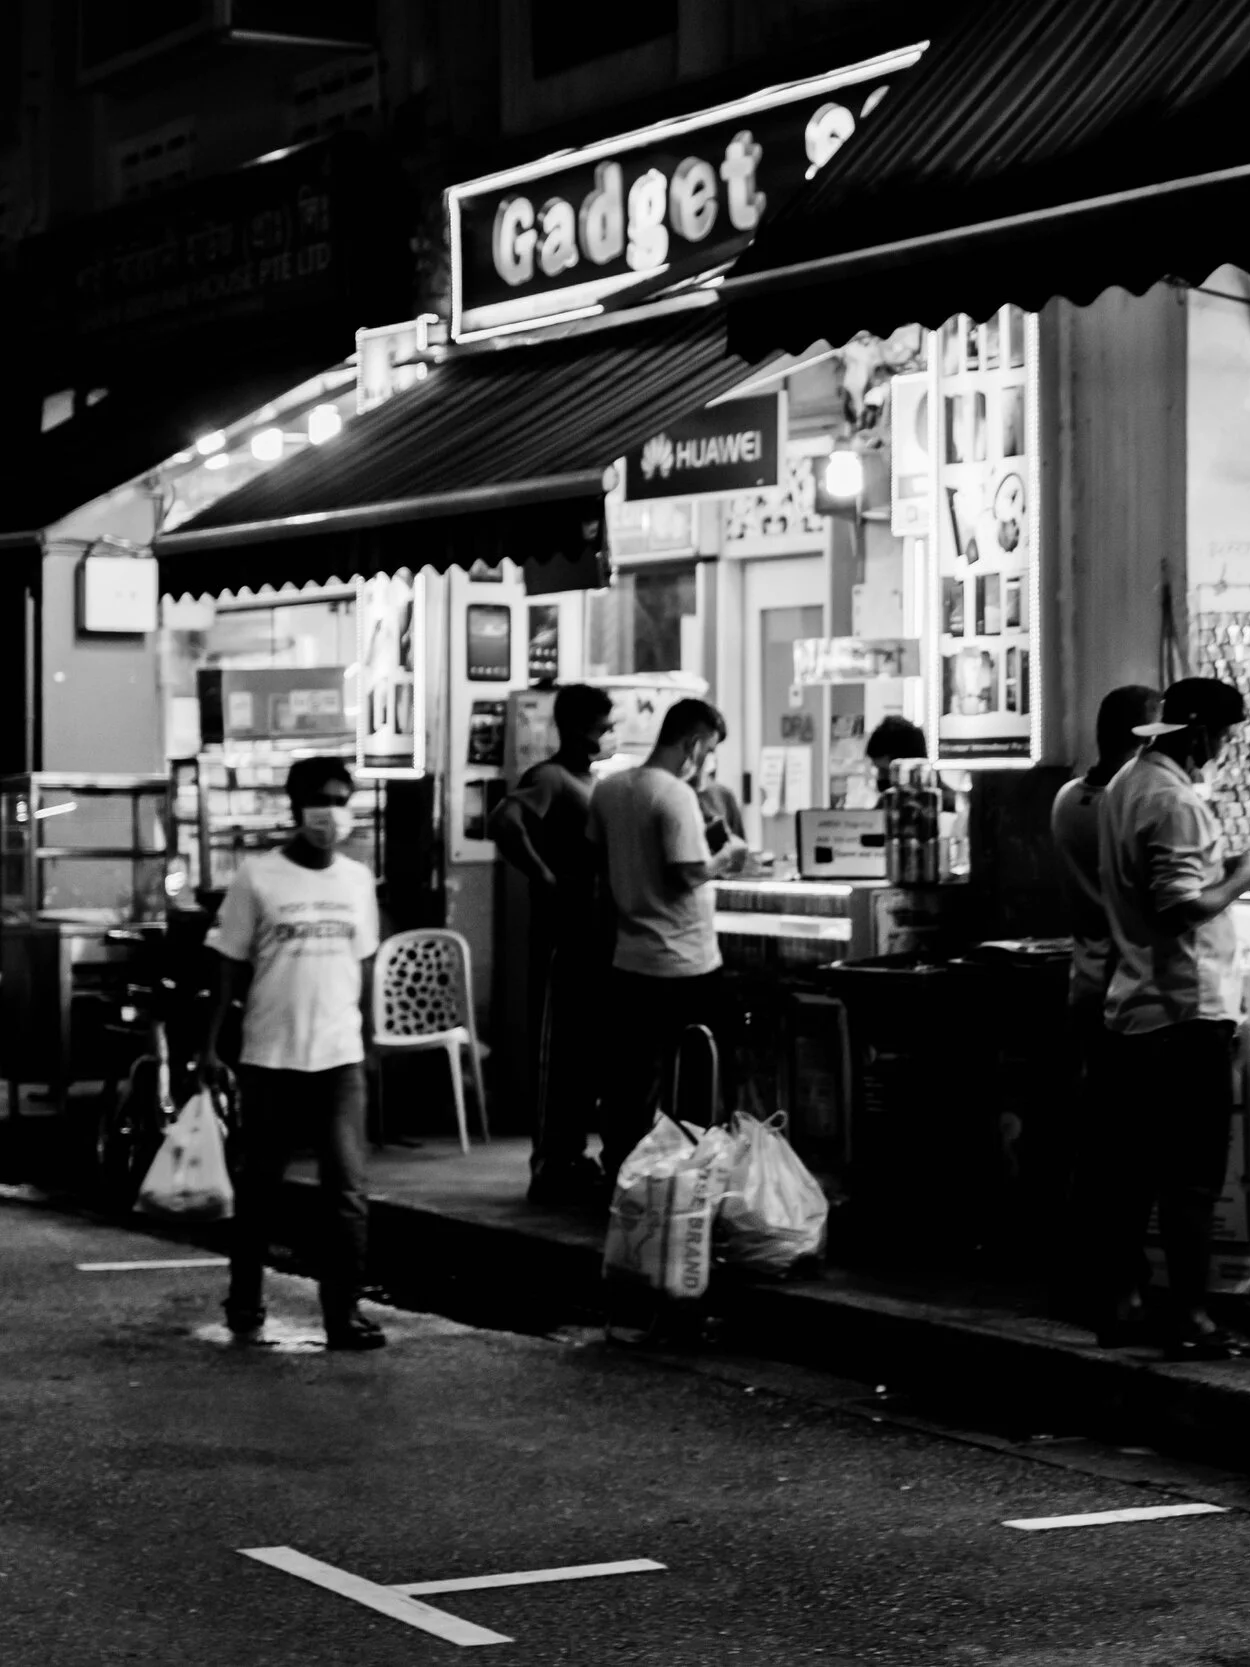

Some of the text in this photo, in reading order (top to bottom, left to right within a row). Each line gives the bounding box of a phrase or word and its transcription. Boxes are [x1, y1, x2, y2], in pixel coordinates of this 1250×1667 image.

[493, 128, 767, 287] Gadget
[297, 241, 333, 275] LTD
[676, 430, 762, 470] HUAWEI
[683, 1217, 705, 1289] BRAND
